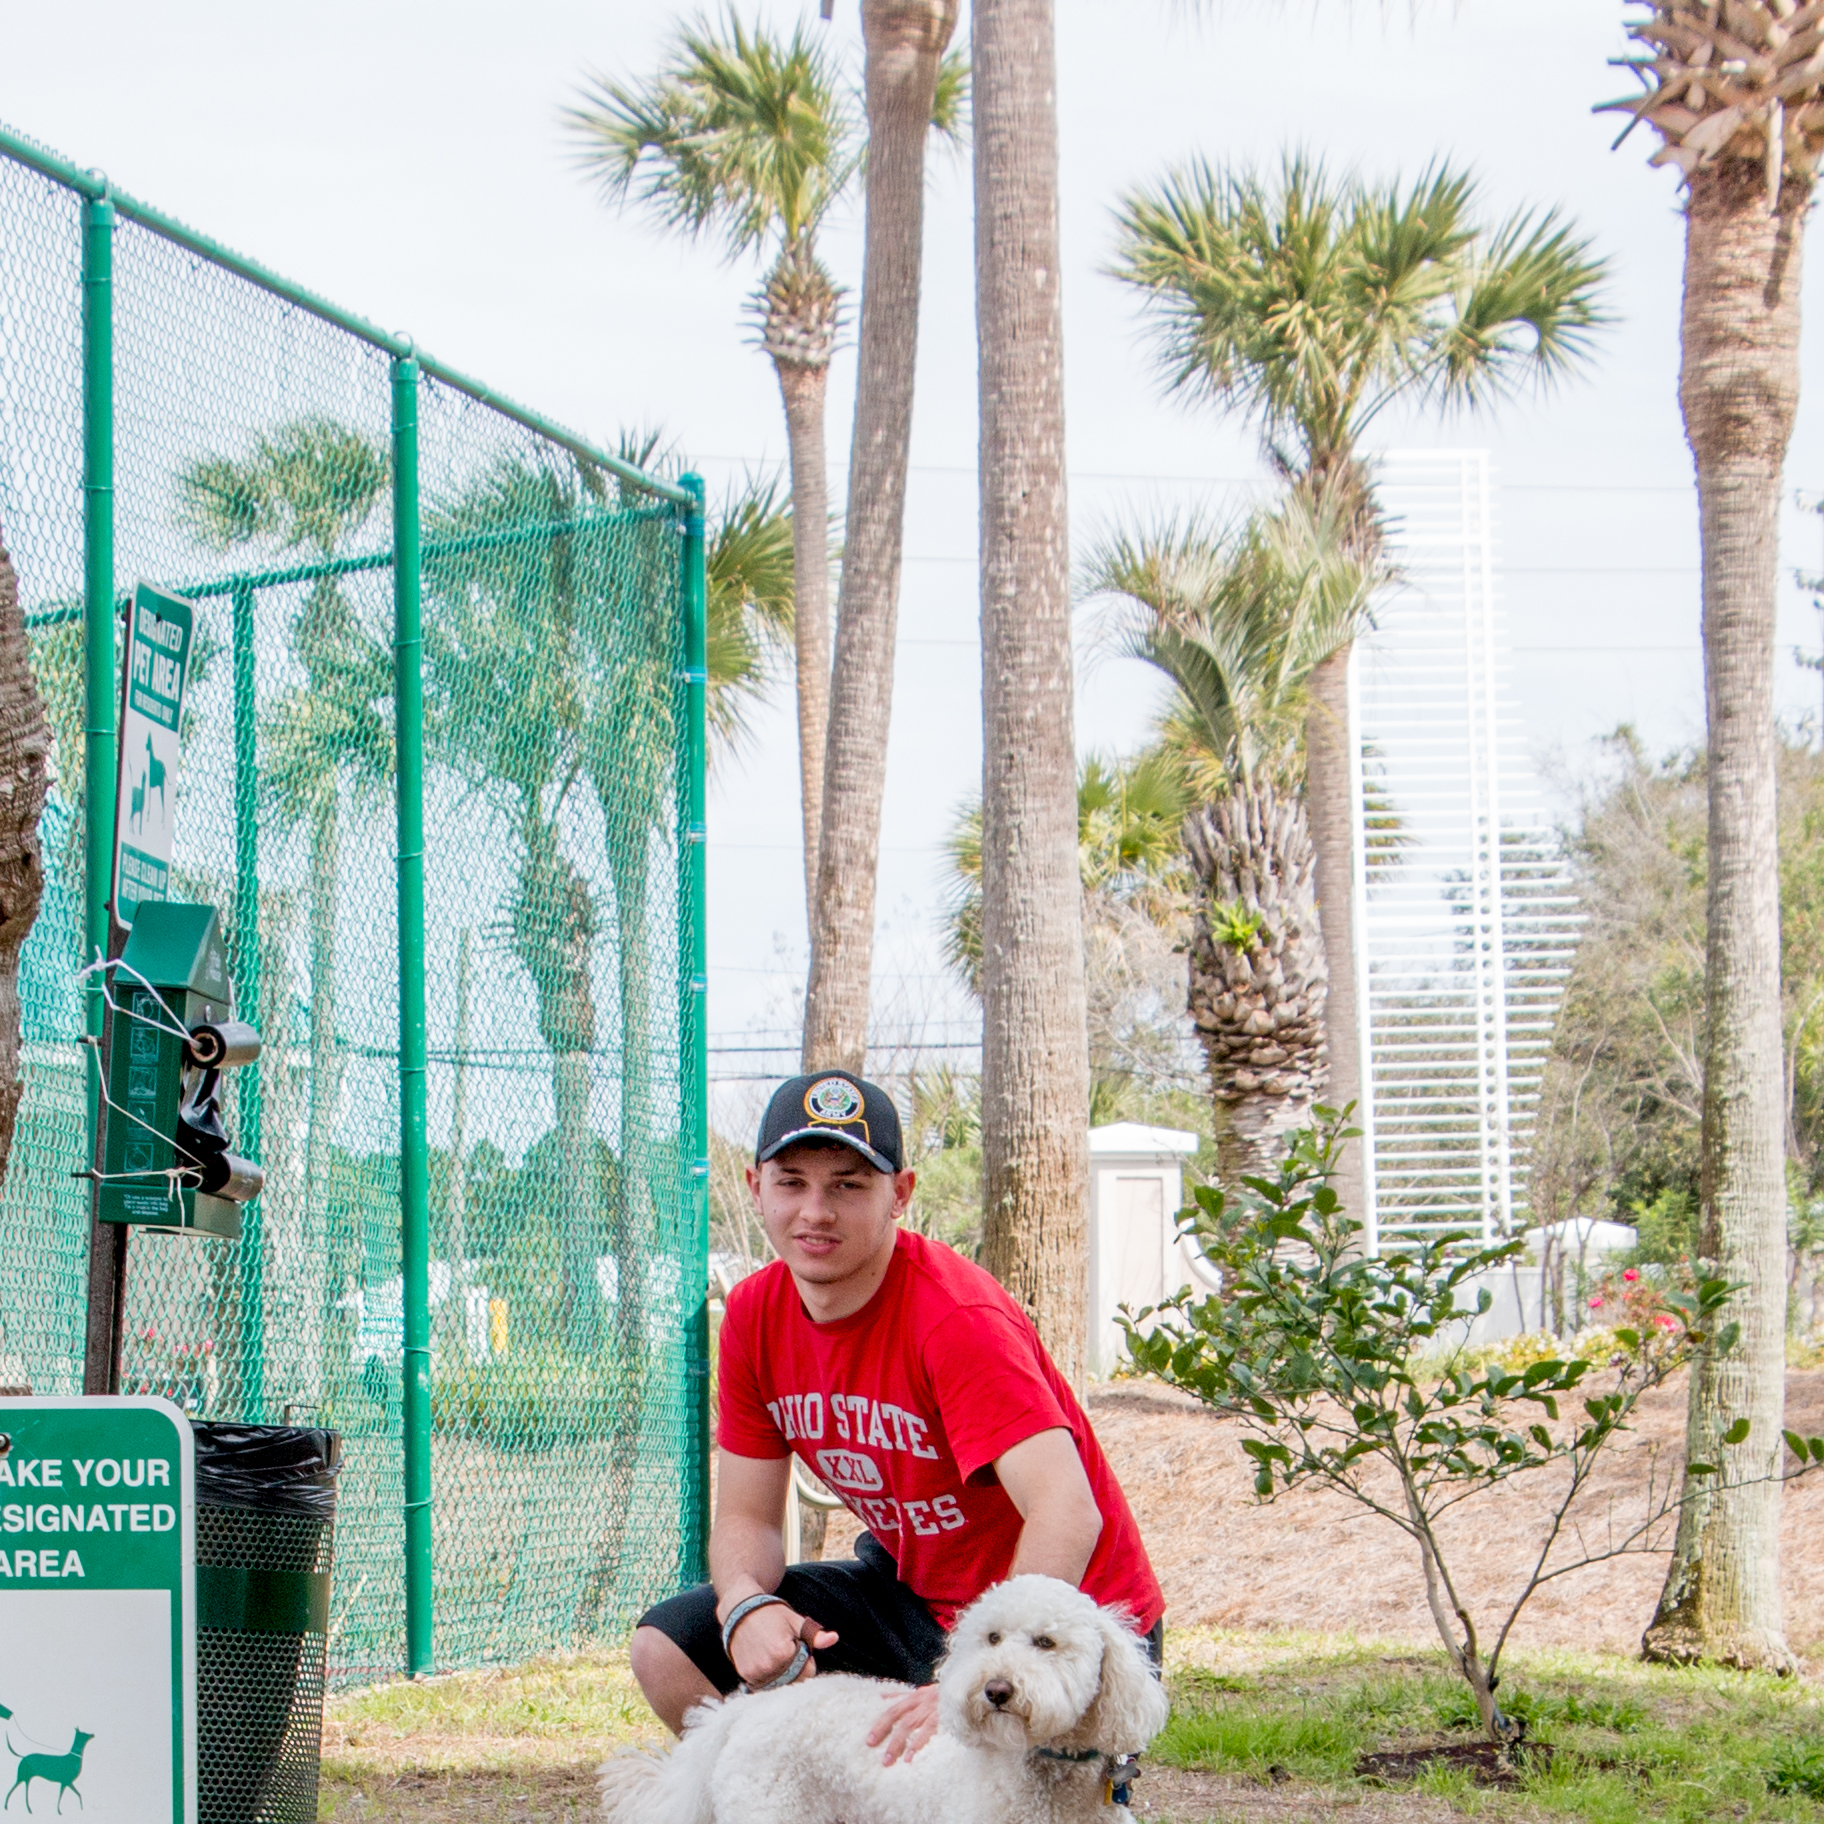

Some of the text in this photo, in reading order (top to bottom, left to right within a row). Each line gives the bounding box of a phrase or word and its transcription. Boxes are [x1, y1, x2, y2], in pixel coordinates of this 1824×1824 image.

[133, 639, 181, 703] PET AREA
[819, 1109, 847, 1118] ARMY
[830, 1393, 939, 1460] STATE
[72, 1459, 171, 1488] YOUR
[824, 1455, 877, 1485] XXL
